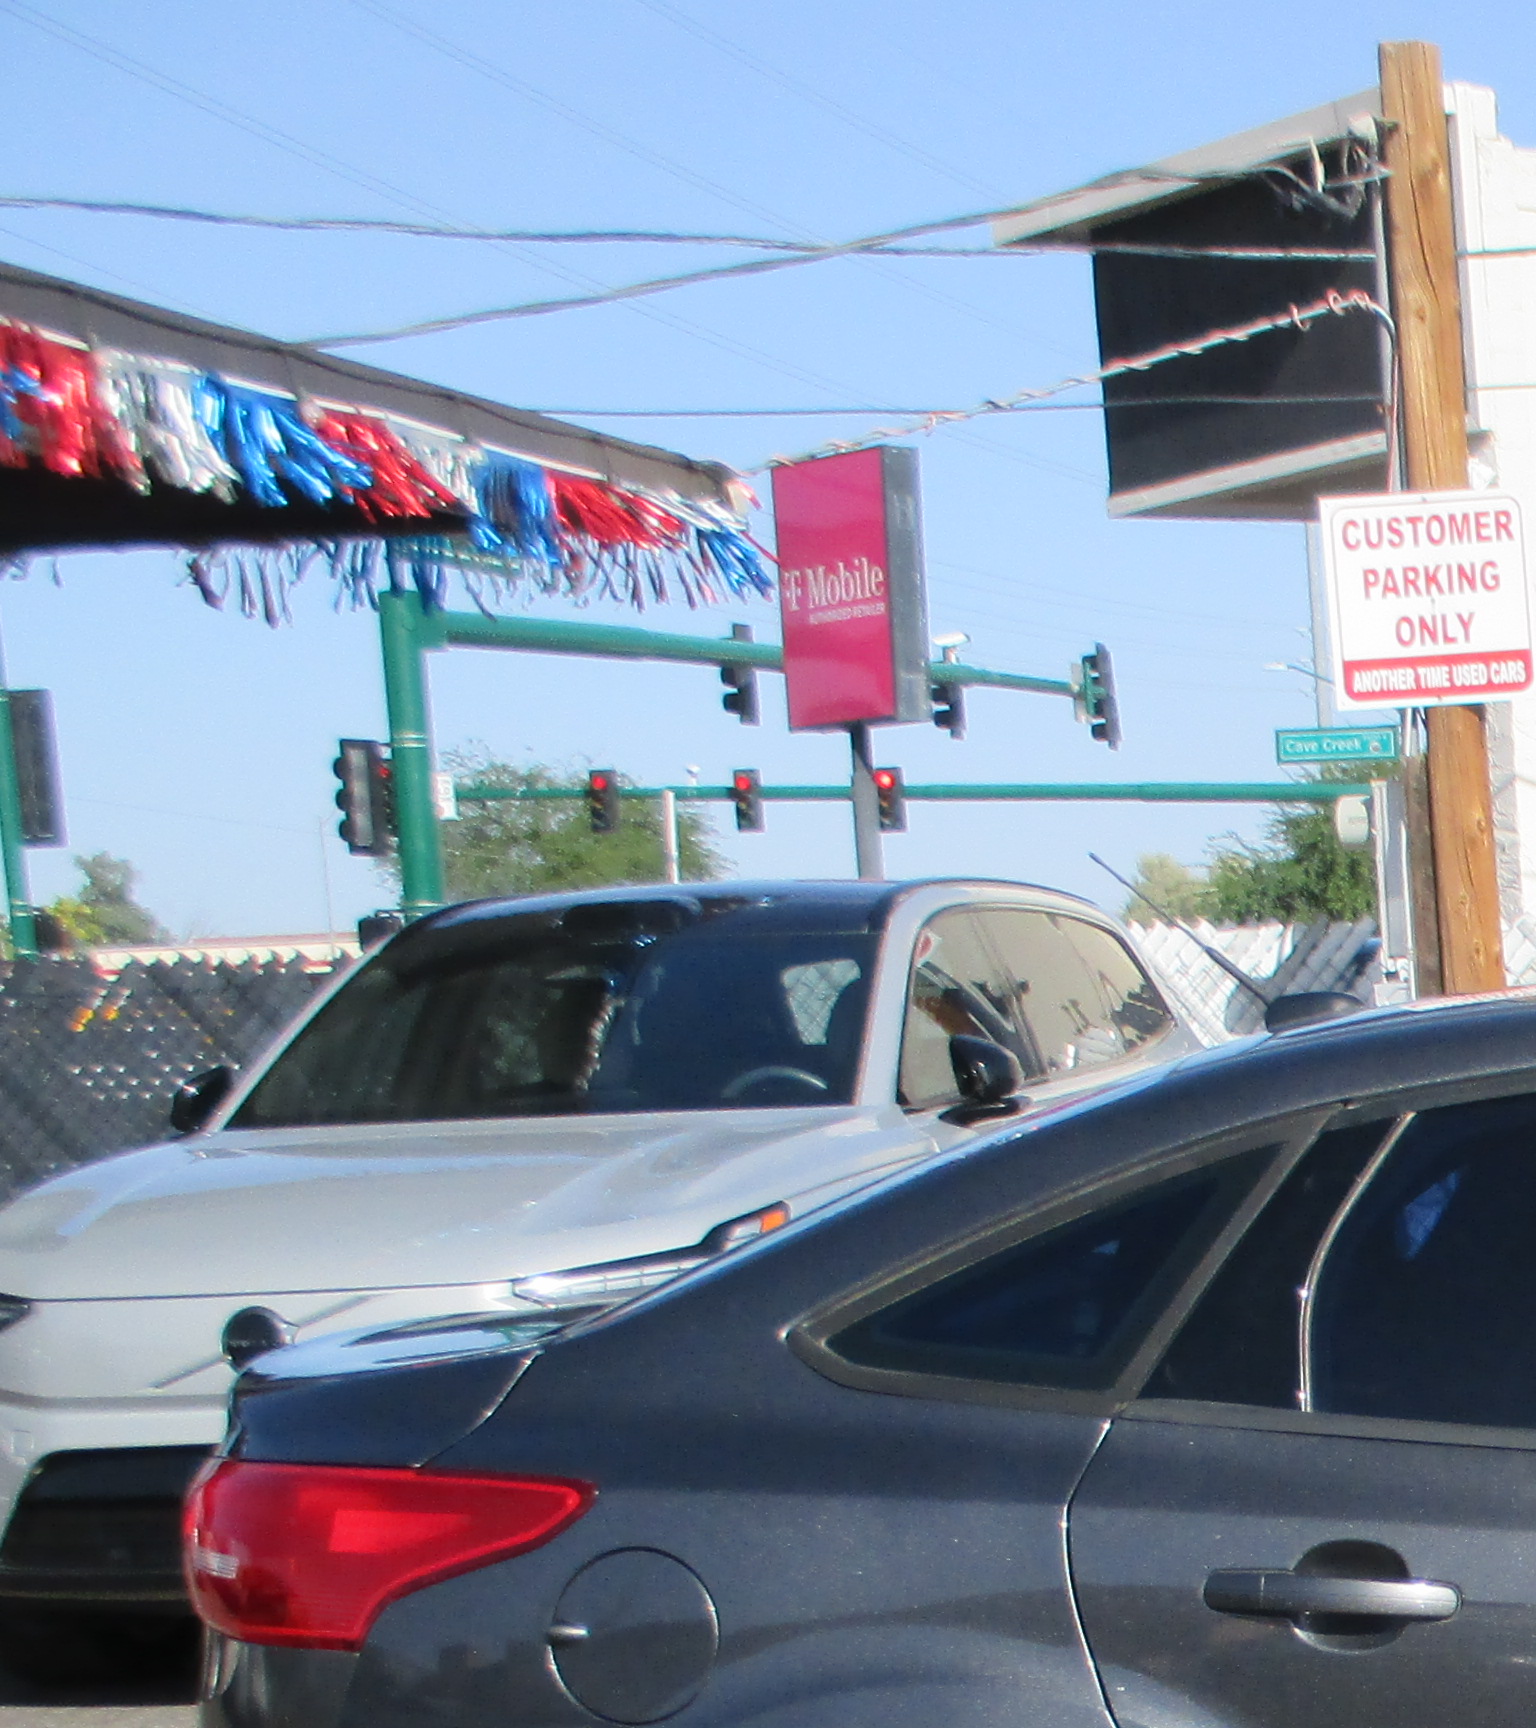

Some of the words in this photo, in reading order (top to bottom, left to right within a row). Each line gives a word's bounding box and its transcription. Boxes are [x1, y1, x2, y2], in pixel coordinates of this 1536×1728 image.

[1341, 509, 1516, 551] CUSTOMER
[1362, 560, 1501, 600] PARKING
[1395, 611, 1475, 647] ONLY
[1353, 666, 1417, 693] ANOTHER
[1417, 664, 1452, 690] TIME
[1452, 661, 1488, 688] USED
[1489, 659, 1527, 686] CARS
[1285, 738, 1319, 754] Cave
[1322, 737, 1363, 753] Creek
